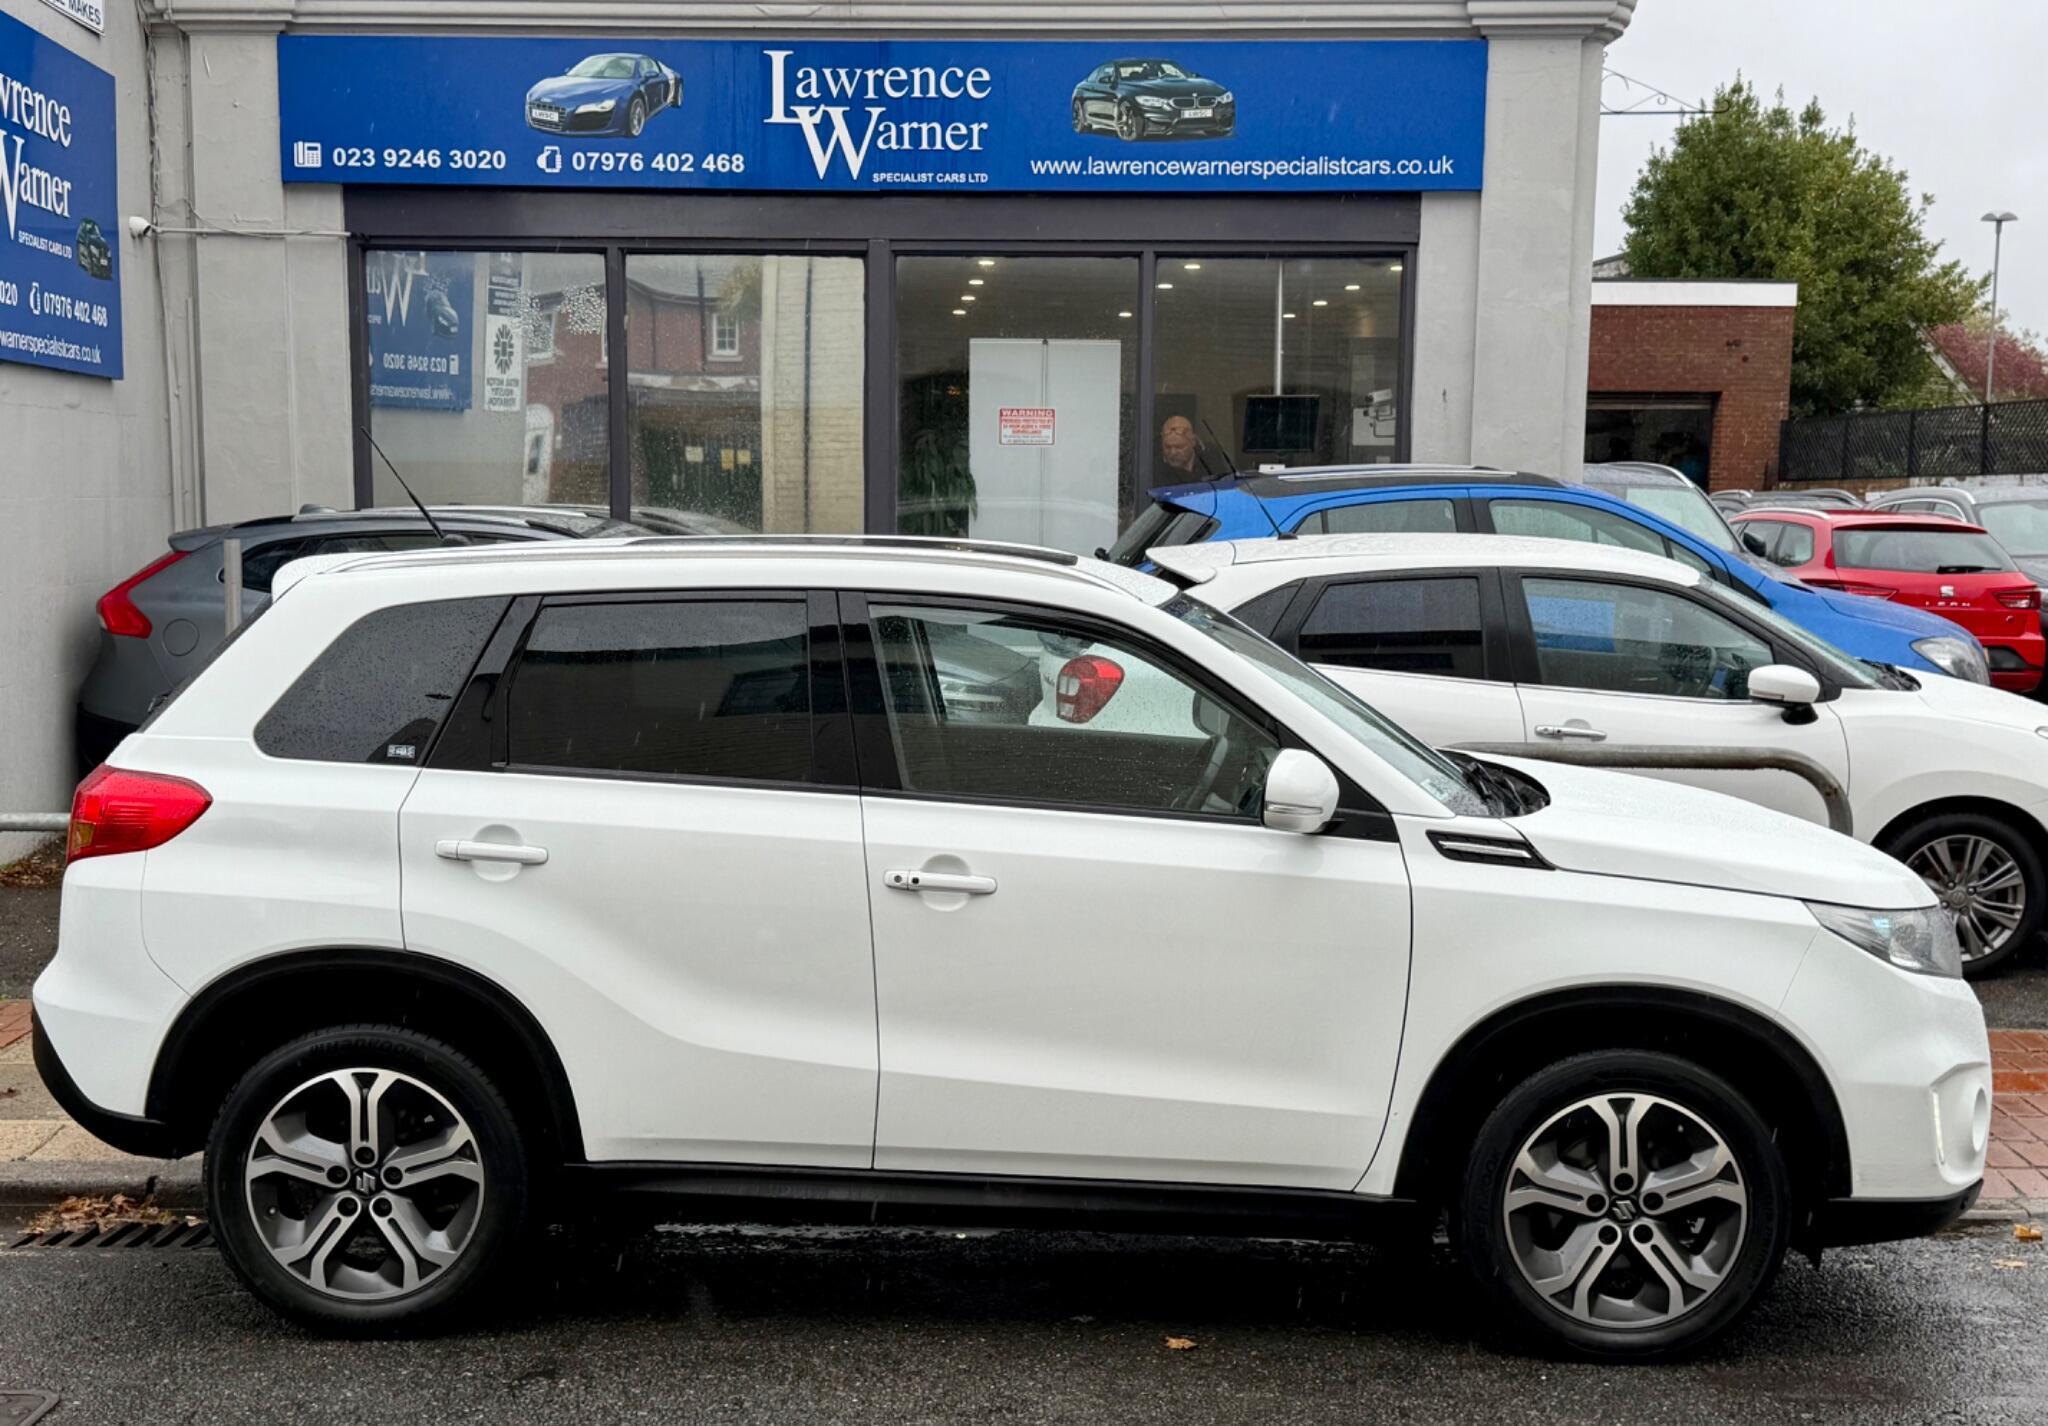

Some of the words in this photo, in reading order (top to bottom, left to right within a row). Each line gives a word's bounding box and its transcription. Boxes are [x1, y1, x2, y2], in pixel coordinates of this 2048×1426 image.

[763, 50, 992, 124] Lawrence
[789, 104, 989, 181] Warner
[333, 147, 376, 167] 023
[383, 148, 441, 168] 9246
[449, 150, 507, 169] 3020
[572, 152, 644, 171] 07976
[651, 153, 694, 172] 402
[701, 154, 745, 173] 468
[1030, 155, 1454, 180] www.lawrencewarnerspecialistcars.co.uk
[872, 172, 933, 183] SPECIALIST
[936, 173, 966, 183] CARS
[968, 173, 989, 184] LTD
[18, 230, 48, 252] SPECIALIST
[48, 240, 63, 256] CARS
[62, 245, 72, 259] LTD
[44, 292, 72, 319] 07976
[74, 300, 91, 324] 402
[1001, 409, 1053, 417] WARNING
